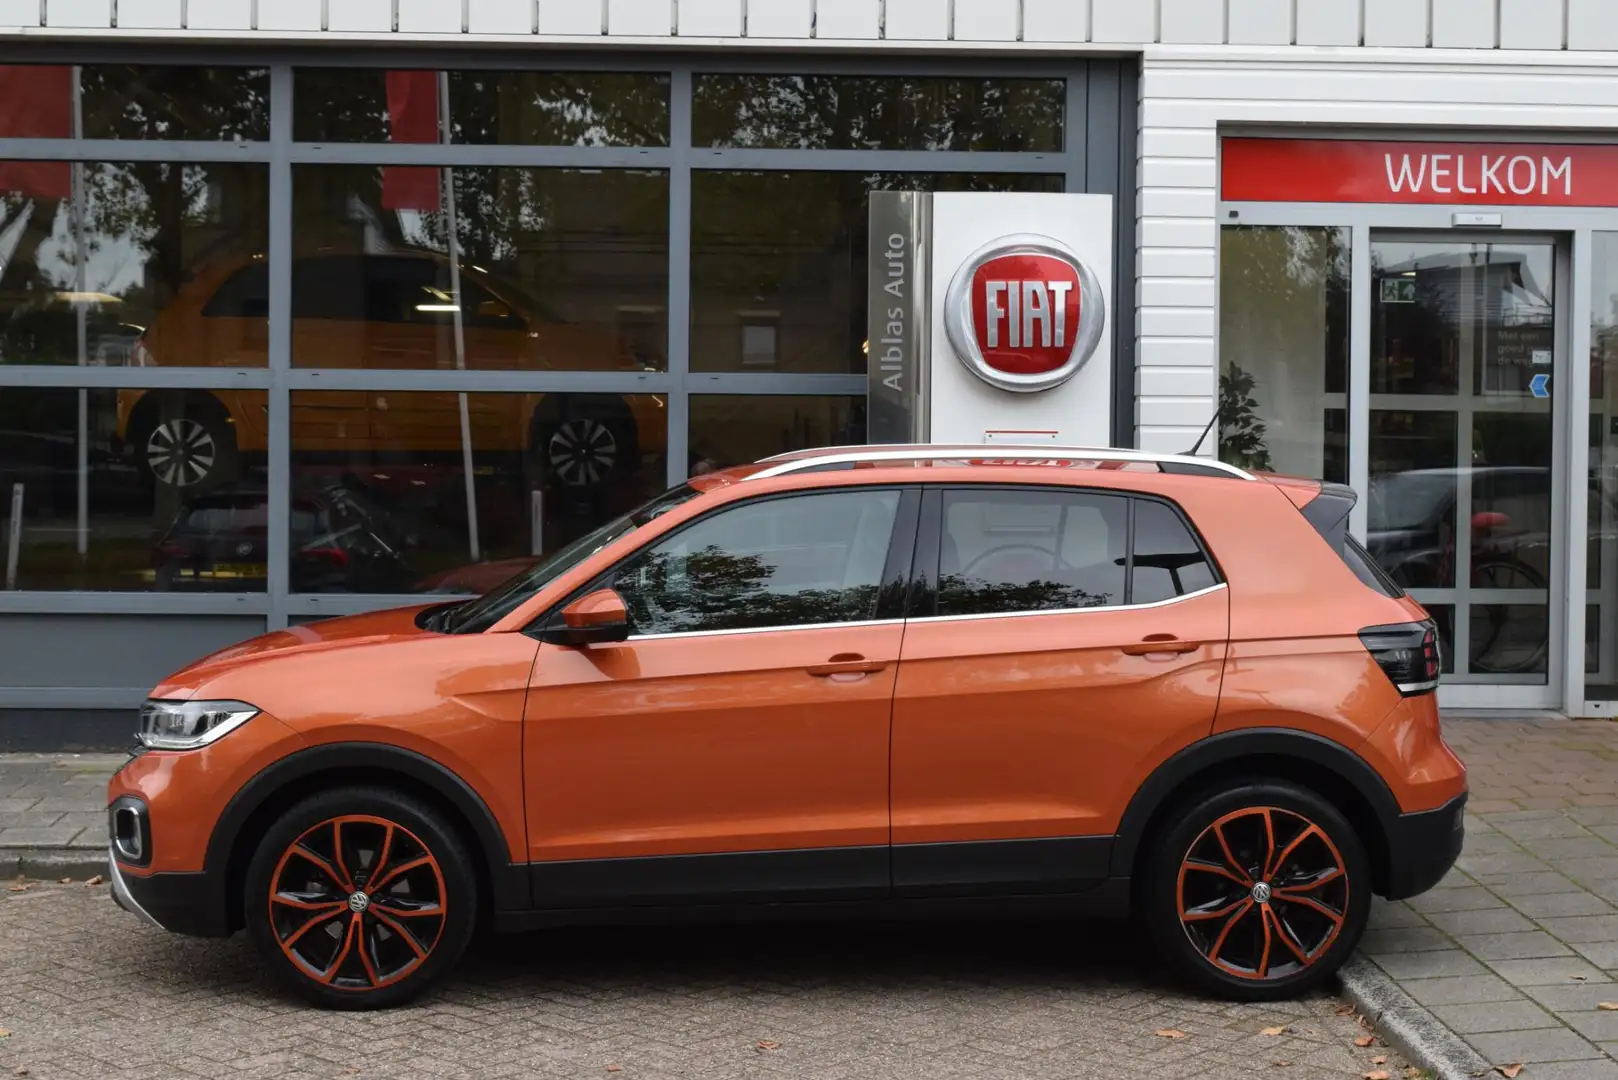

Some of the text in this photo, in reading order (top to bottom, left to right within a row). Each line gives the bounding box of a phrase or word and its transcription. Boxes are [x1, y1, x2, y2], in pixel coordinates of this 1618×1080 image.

[1384, 153, 1572, 196] WELKOM
[880, 233, 905, 392] Alblas Auto
[985, 280, 1073, 348] FIAT
